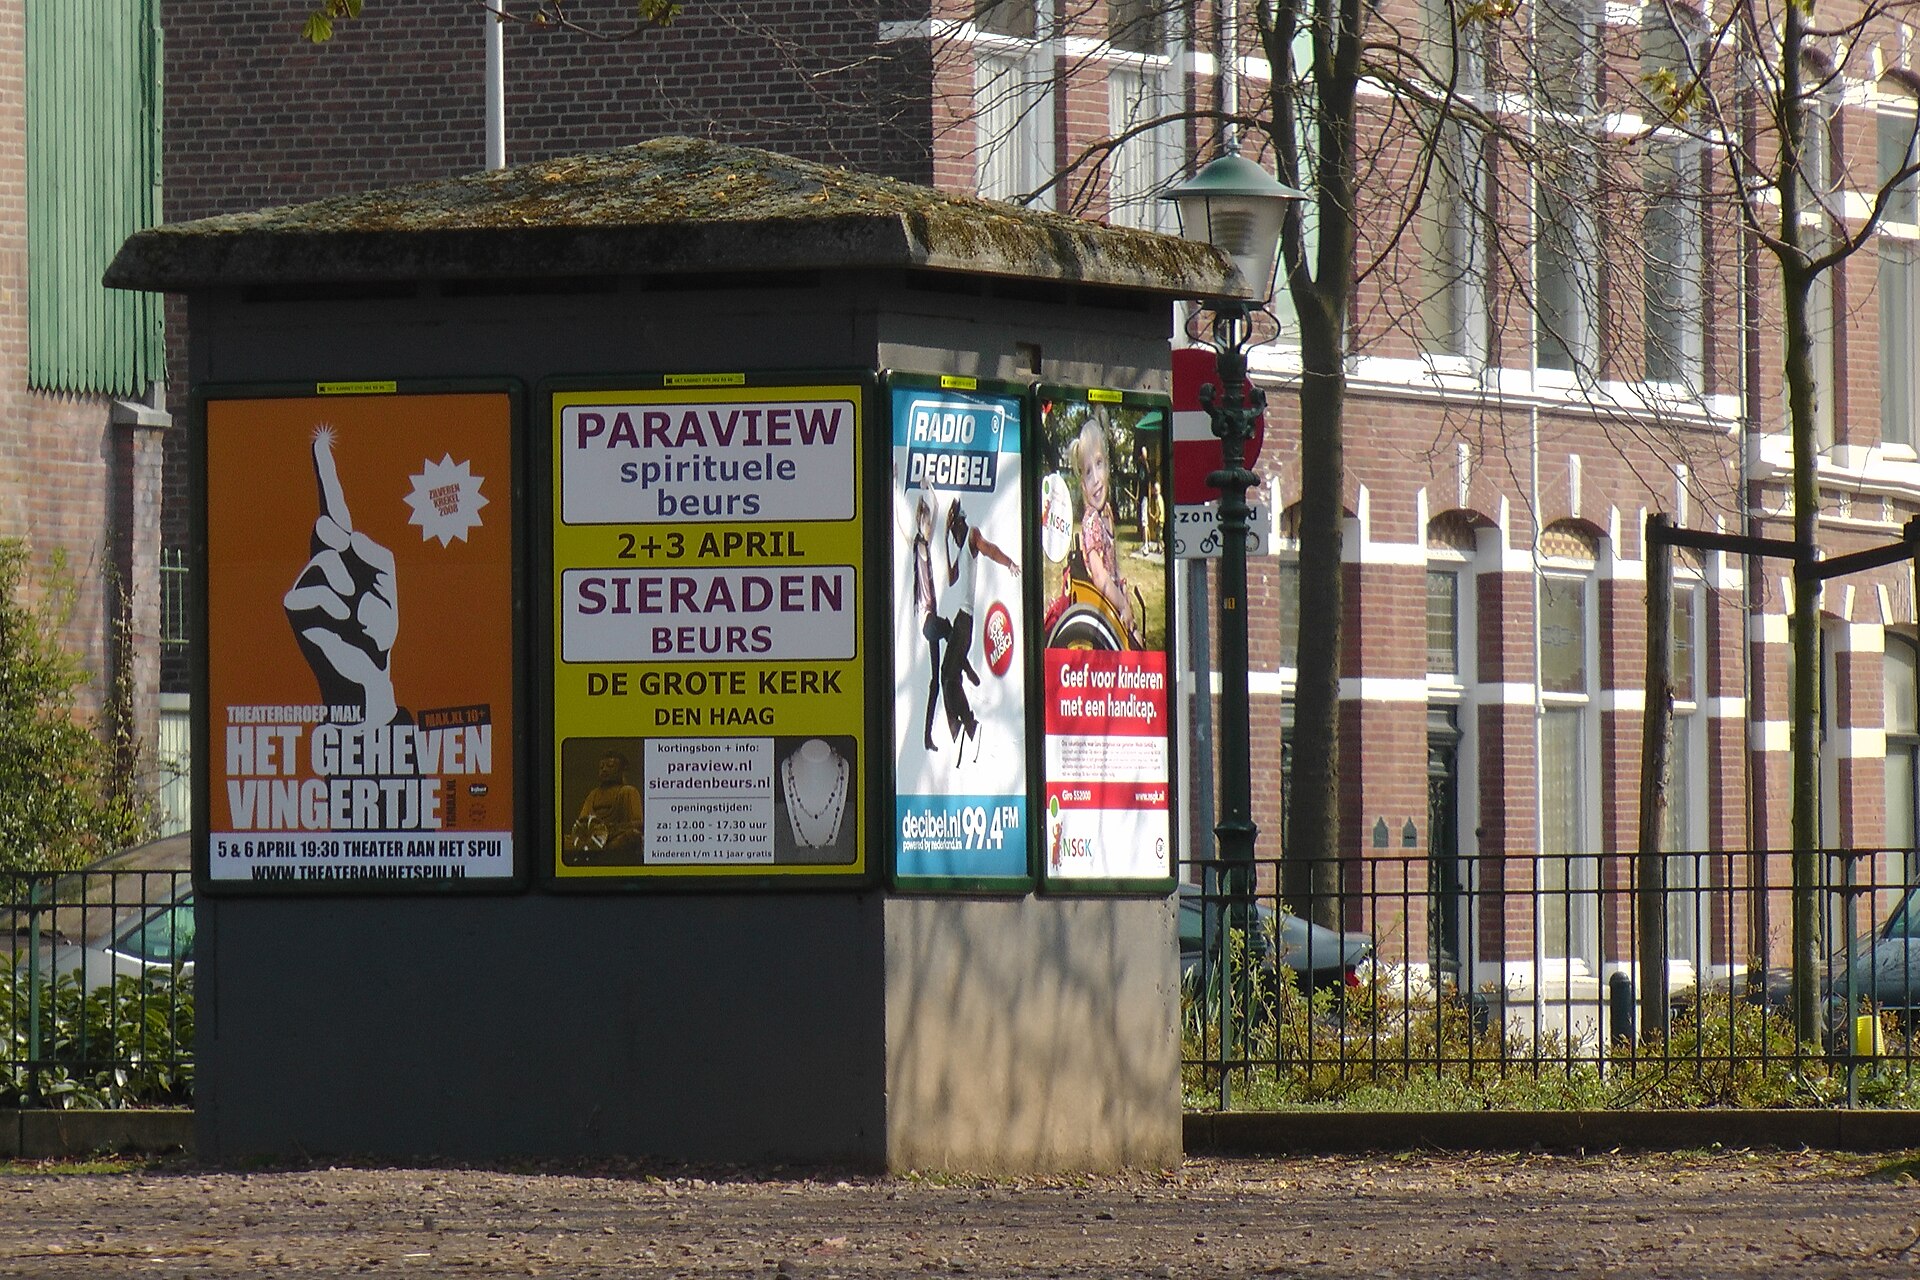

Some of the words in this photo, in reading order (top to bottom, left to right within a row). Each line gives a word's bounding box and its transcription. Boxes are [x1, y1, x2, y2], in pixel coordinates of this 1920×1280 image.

[577, 408, 842, 449] PARAVIEW
[914, 411, 976, 444] RADIO
[620, 453, 796, 489] spirituele
[910, 453, 991, 486] DECIBEL
[434, 493, 459, 508] KREKEL
[438, 503, 458, 516] 2008
[657, 489, 760, 516] beurs
[1050, 512, 1070, 536] NSGK
[618, 532, 685, 559] 2+3
[698, 531, 805, 558] APRIL
[578, 574, 842, 614] SIERADEN
[651, 625, 773, 653] BEURS
[588, 672, 627, 696] DE
[640, 671, 746, 696] GROTE
[759, 670, 842, 694] KERK
[1060, 663, 1089, 688] Geef
[1091, 671, 1116, 688] voor
[1118, 664, 1163, 689] kinderen
[227, 705, 328, 722] THEATERGROEP
[331, 705, 364, 722] MAX.
[654, 708, 701, 726] DEN
[710, 707, 774, 725] HAAG
[1060, 695, 1083, 716] met
[1085, 700, 1105, 716] een
[1108, 693, 1157, 724] handicap.
[226, 726, 302, 775] HET
[311, 724, 491, 775] GEHEVEN
[658, 744, 721, 754] kortingsbon
[736, 743, 759, 752] info:
[668, 760, 752, 774] paraview.nl
[649, 777, 770, 789] sieradenbeurs.nl
[227, 778, 441, 829] VINGERTJE
[1062, 789, 1073, 801] Giro
[671, 803, 752, 813] openingstijden:
[656, 822, 671, 830] za:
[676, 821, 705, 829] 12.00
[717, 821, 745, 829] 17.30
[902, 808, 960, 838] decibel.nl
[962, 806, 1003, 849] 99.4
[1003, 806, 1019, 828] FM
[218, 841, 227, 857] 5
[231, 842, 241, 857] &
[244, 841, 253, 857] 6
[257, 841, 297, 857] APRIL
[300, 840, 339, 857] 19:30
[343, 840, 403, 857] THEATER
[407, 840, 435, 857] AAN
[438, 840, 464, 857] HET
[468, 840, 501, 856] SPUI
[676, 834, 705, 842] 11.00
[717, 834, 745, 842] 17.30
[903, 839, 923, 853] powered
[924, 838, 931, 852] by
[1063, 838, 1092, 857] NSGK
[652, 850, 690, 858] kinderen
[693, 850, 710, 858] t/m
[726, 850, 744, 859] jaar
[746, 850, 772, 859] gratis
